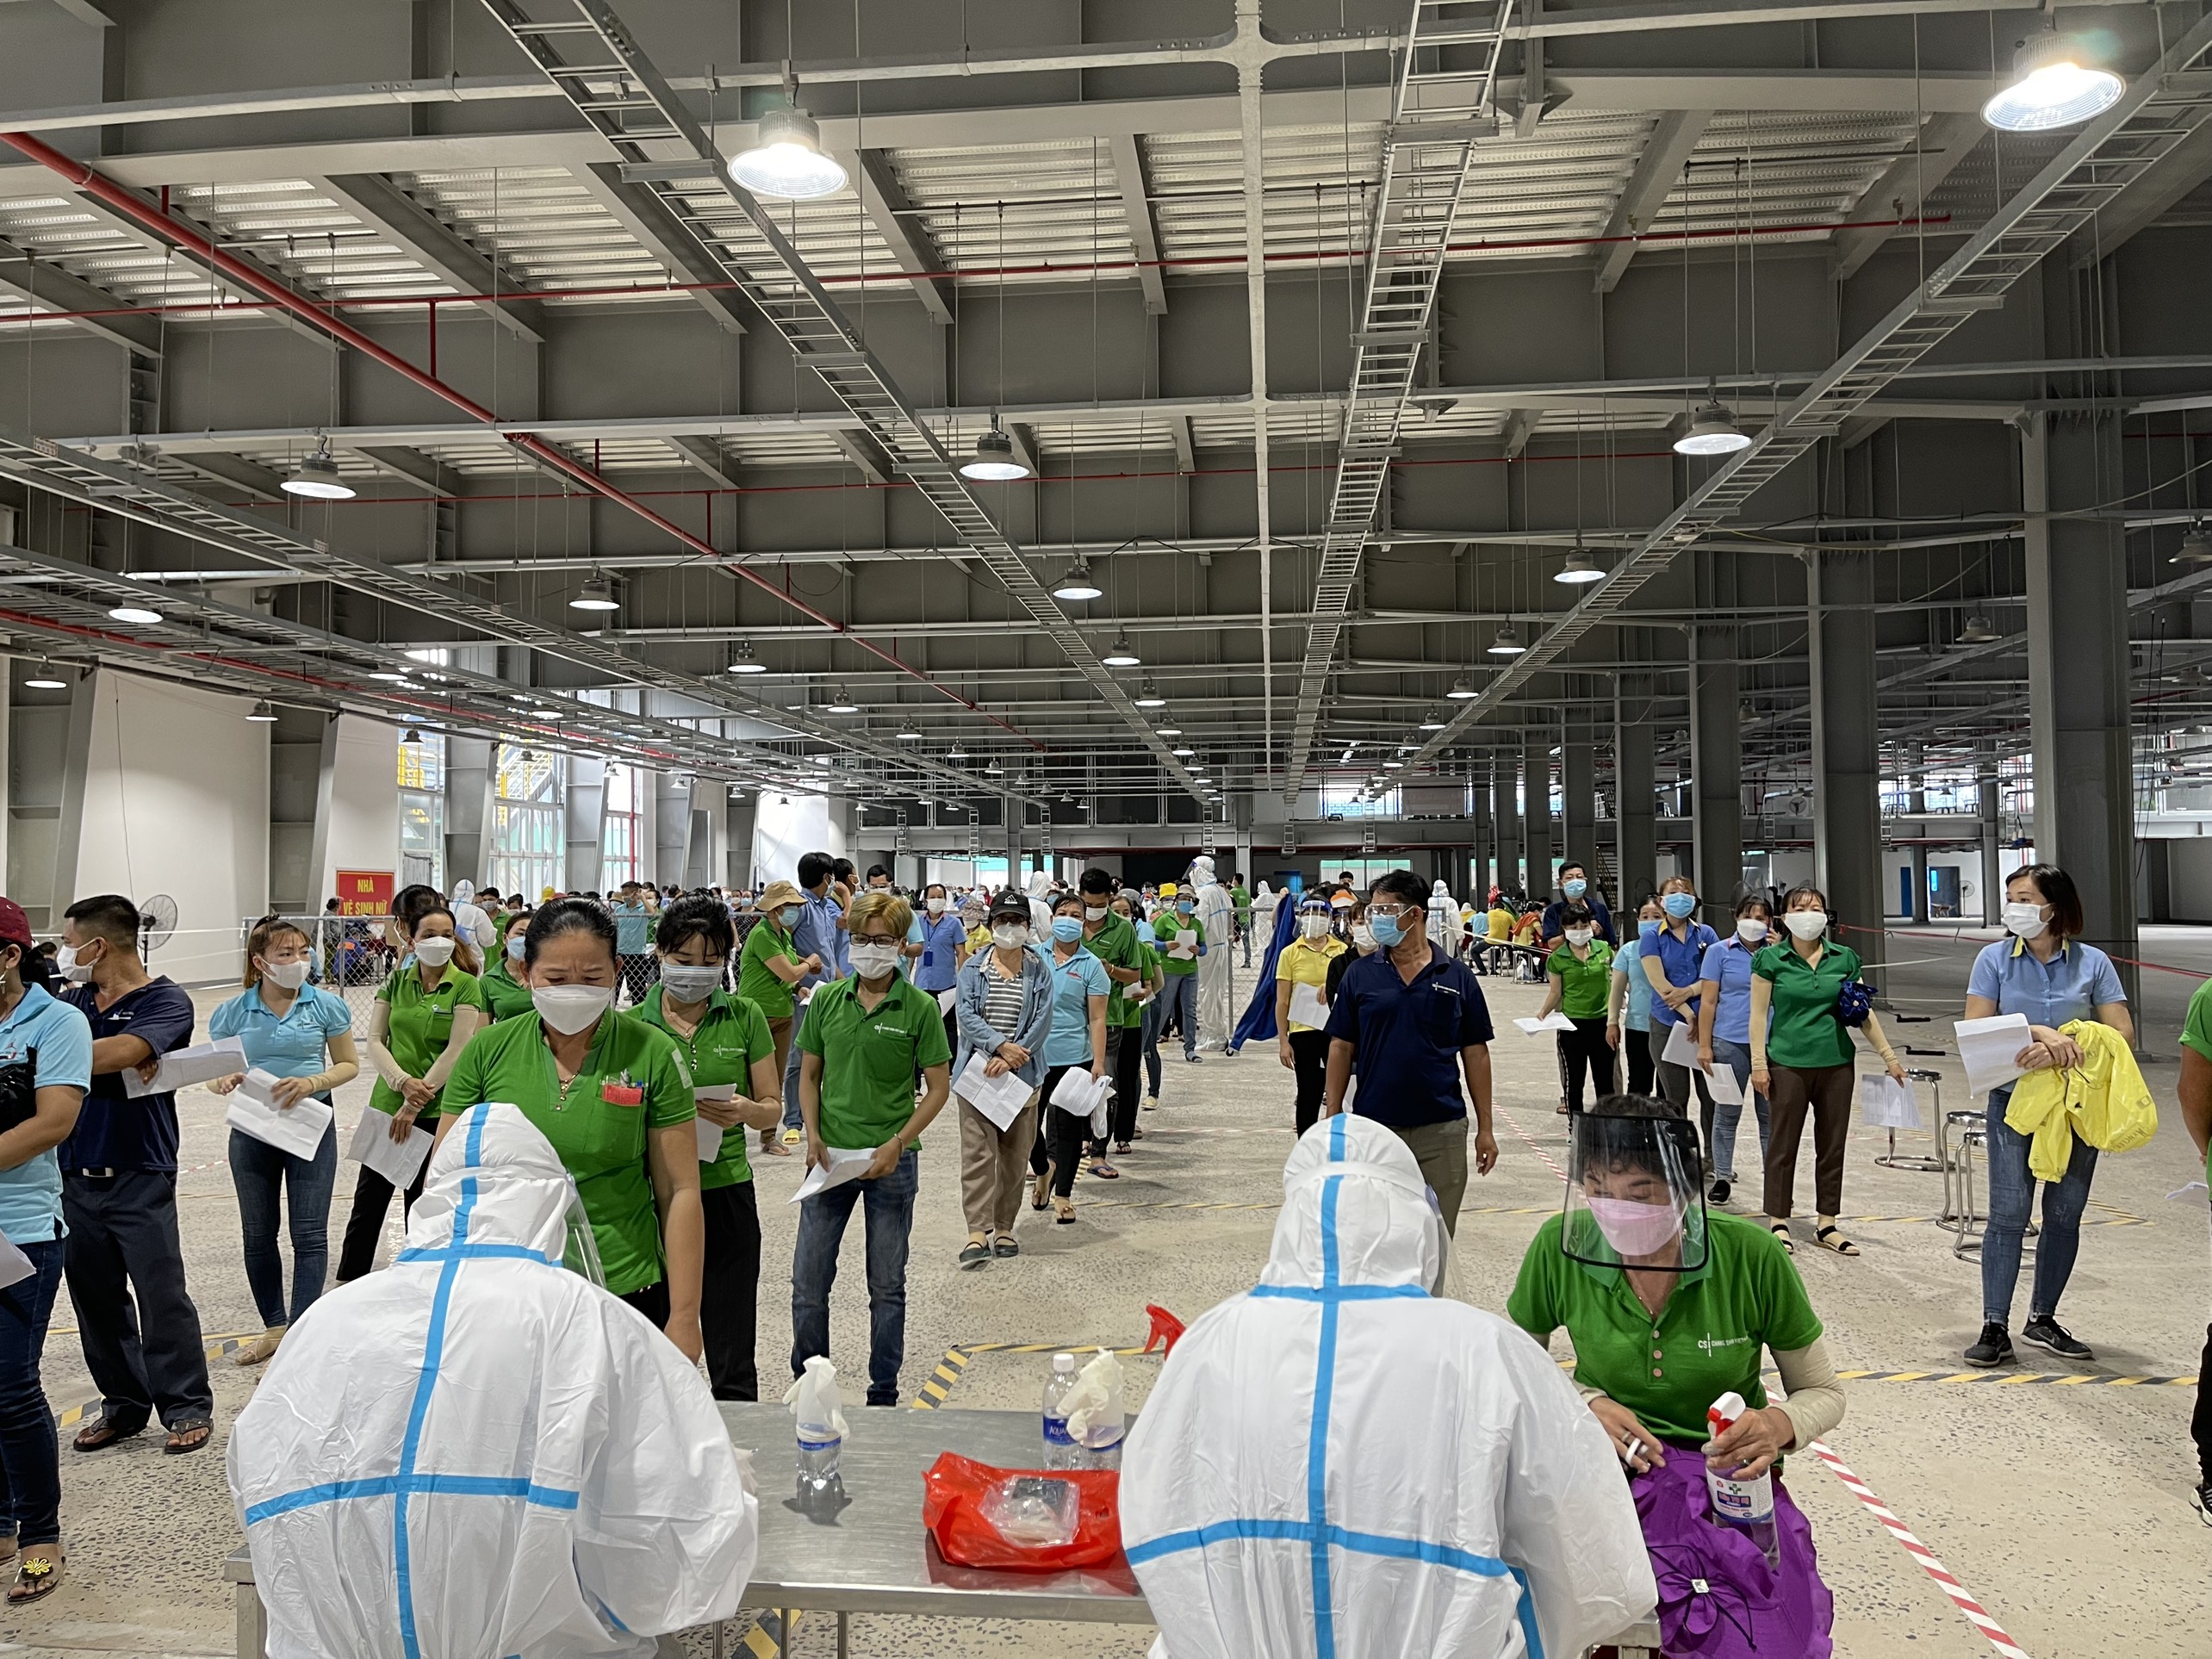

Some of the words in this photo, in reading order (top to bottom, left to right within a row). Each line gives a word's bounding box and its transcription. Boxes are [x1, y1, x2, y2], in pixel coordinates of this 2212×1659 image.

[357, 876, 374, 892] NHÀ
[355, 901, 374, 916] SINH
[376, 899, 387, 915] NỮ
[1698, 1339, 1708, 1349] CS
